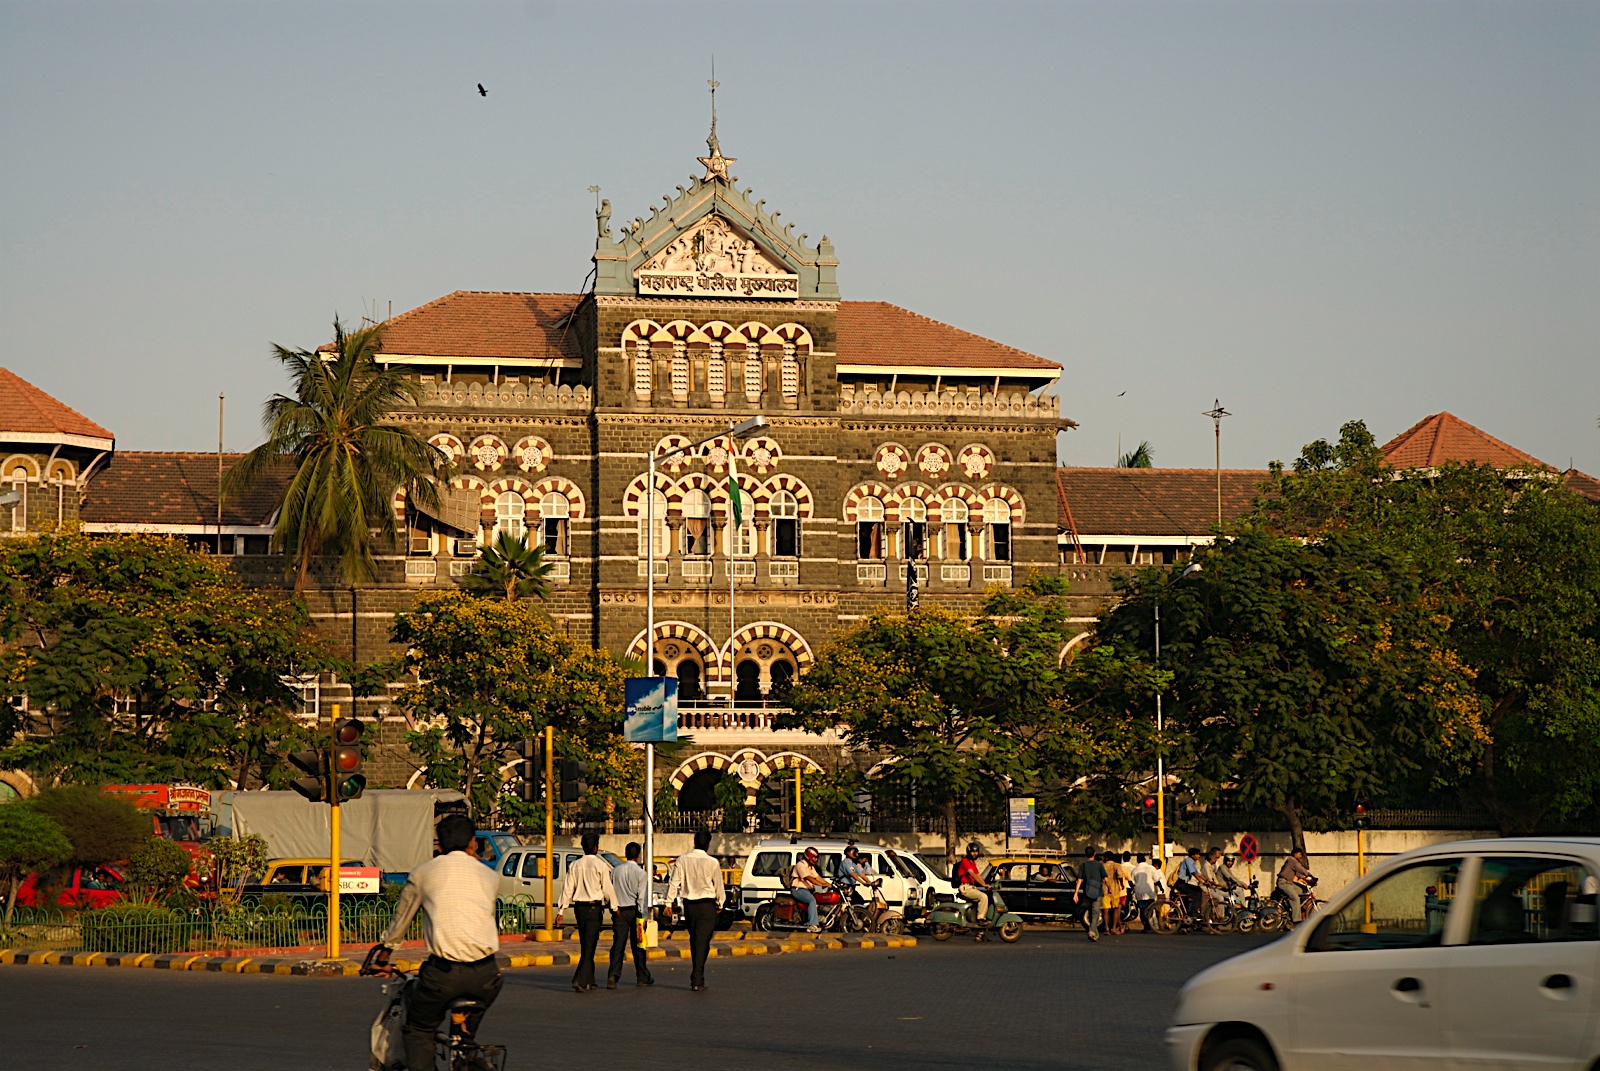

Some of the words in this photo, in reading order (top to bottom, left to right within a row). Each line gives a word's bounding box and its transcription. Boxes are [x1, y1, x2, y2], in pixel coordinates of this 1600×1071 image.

[640, 274, 694, 292] महाराष्ट्र
[740, 278, 798, 295] मुख्यालय
[339, 881, 354, 889] SBC
